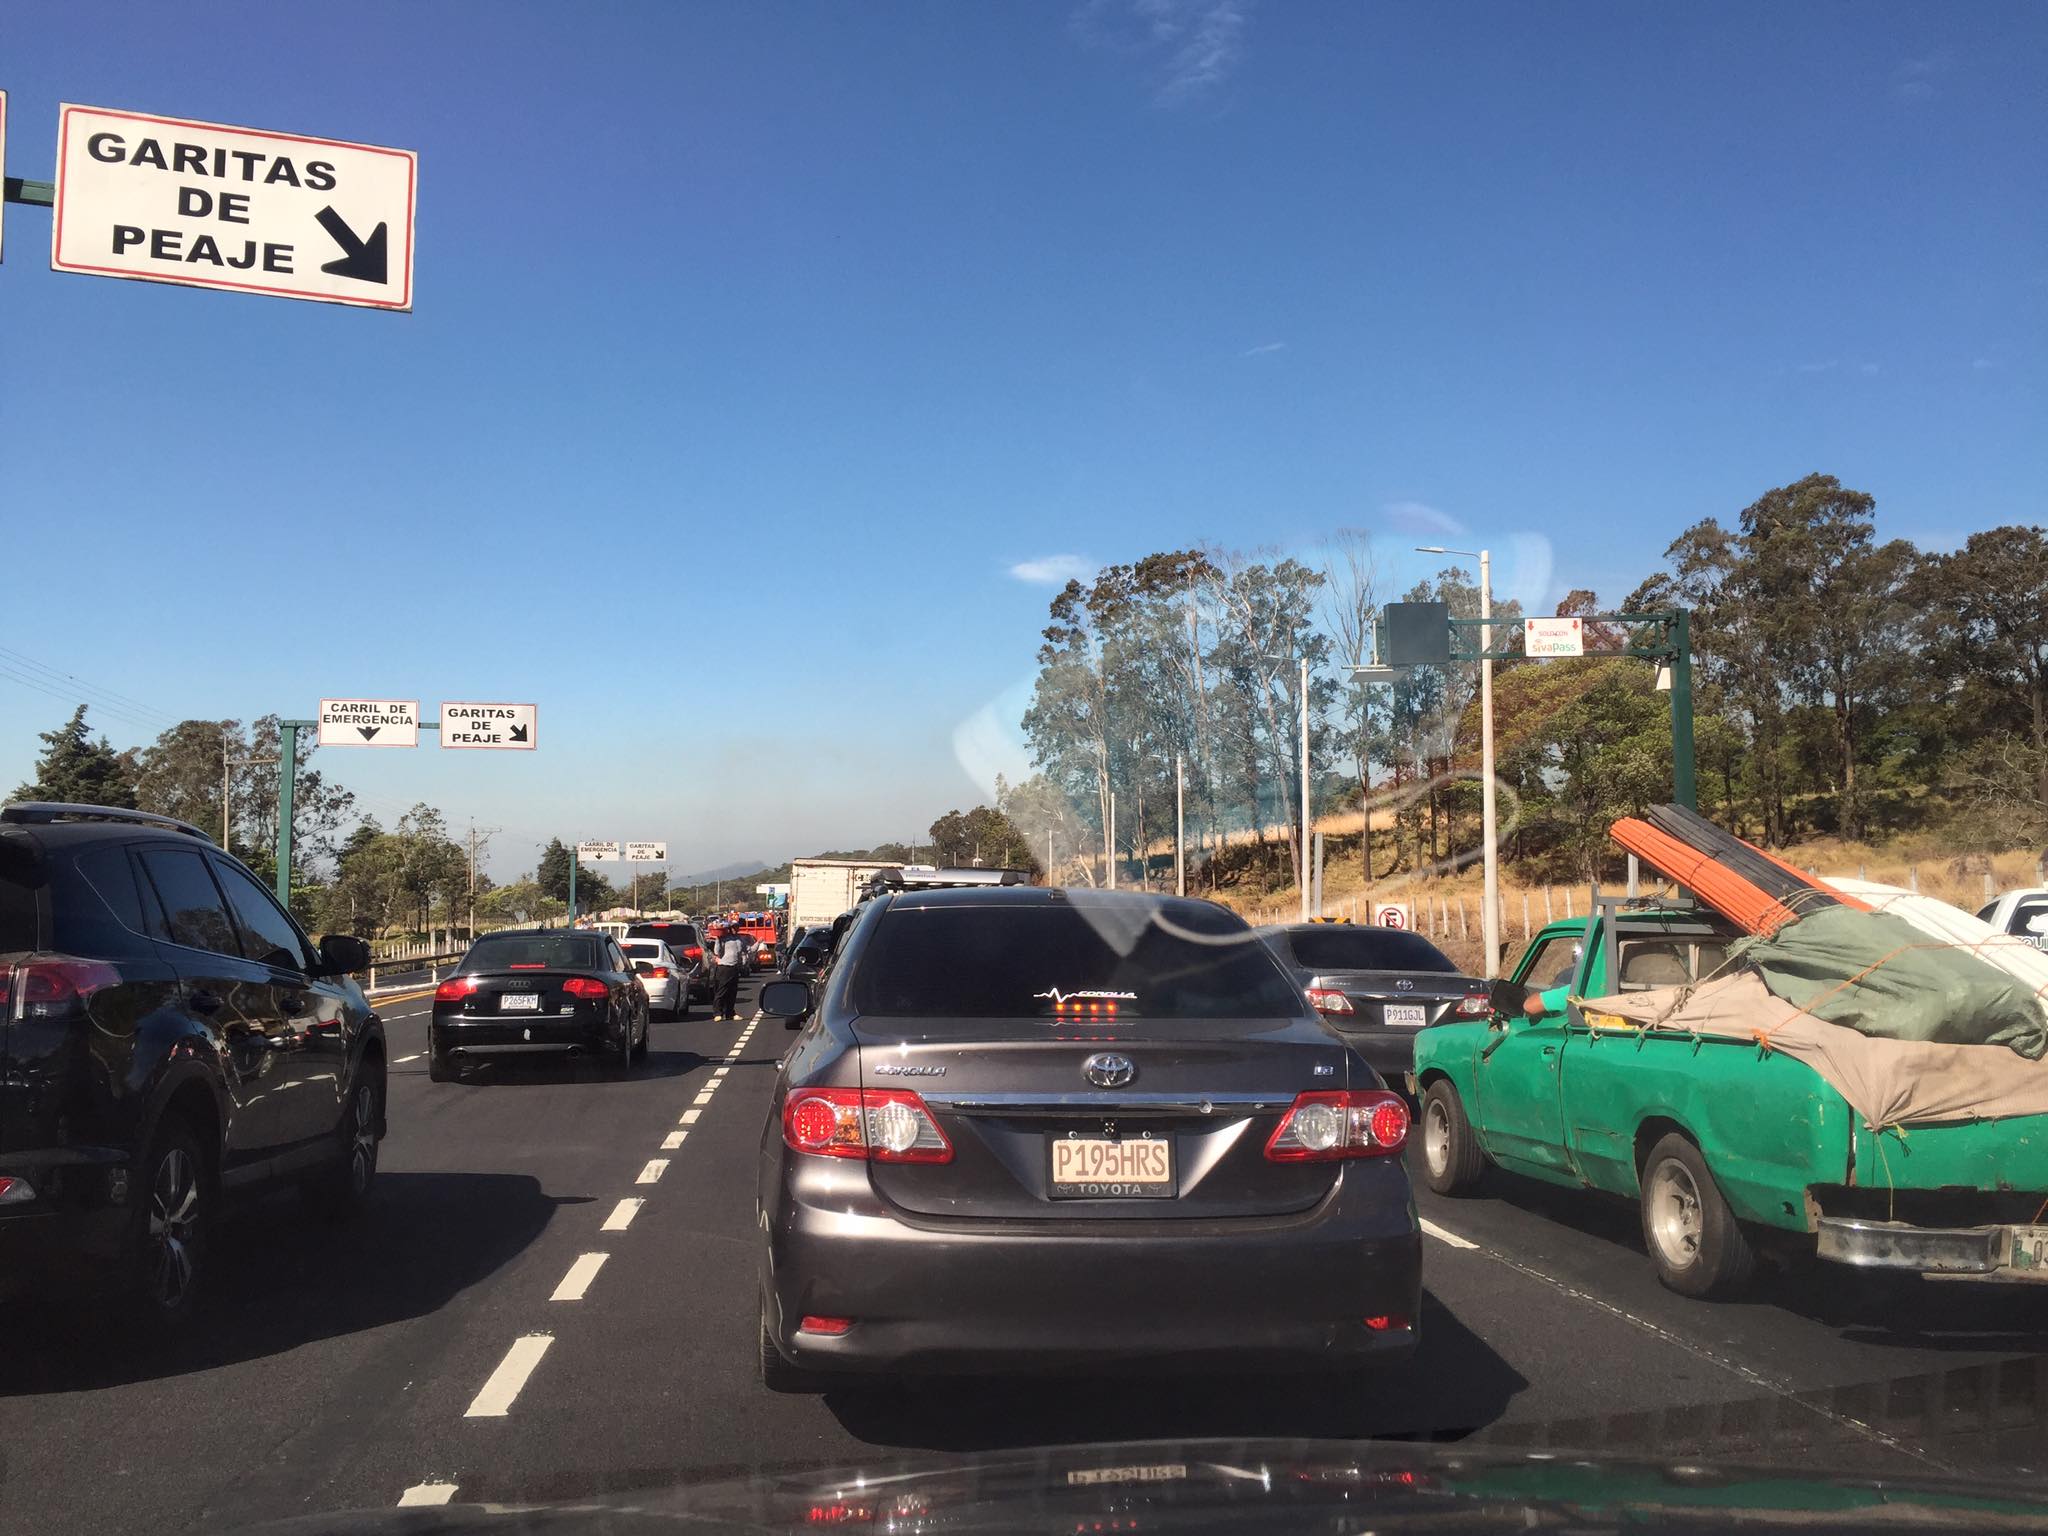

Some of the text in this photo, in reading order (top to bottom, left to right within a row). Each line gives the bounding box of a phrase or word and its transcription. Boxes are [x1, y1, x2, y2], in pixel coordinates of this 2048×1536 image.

[87, 132, 337, 191] GARITAS
[178, 186, 251, 225] DE
[112, 224, 294, 275] PEAJE
[330, 703, 407, 714] CARRIL DE
[448, 708, 515, 719] GARITAS
[323, 714, 414, 725] EMERGENCIA
[471, 720, 491, 731] DE
[452, 733, 501, 743] PEAJE
[1079, 990, 1137, 999] COROLLA
[1387, 1009, 1424, 1021] P911GJL
[874, 1065, 947, 1077] COROLLA
[1057, 1144, 1166, 1177] P195HRS
[1078, 1183, 1142, 1195] TOYOTA
